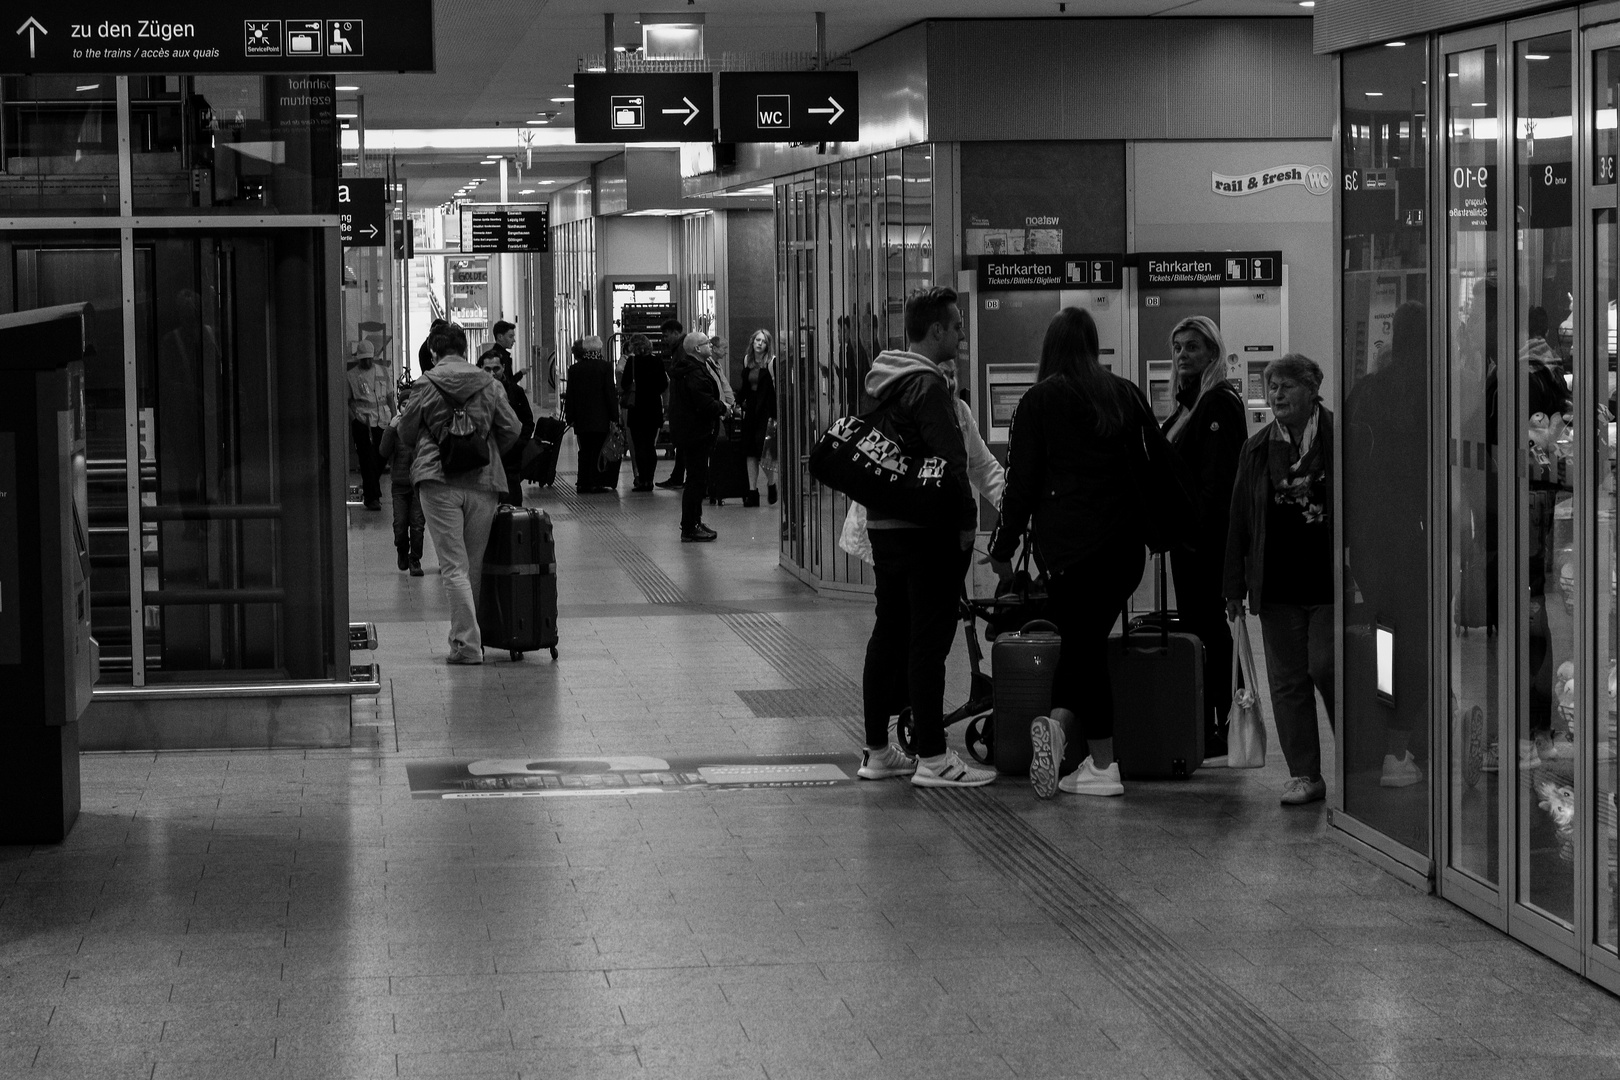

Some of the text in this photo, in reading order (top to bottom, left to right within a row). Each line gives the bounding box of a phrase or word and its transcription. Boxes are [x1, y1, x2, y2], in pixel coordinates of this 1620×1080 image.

[71, 20, 195, 41] zu den Zügen
[73, 48, 83, 58] to
[86, 48, 102, 58] the
[104, 48, 132, 58] trains
[141, 47, 170, 58] accès
[172, 49, 191, 58] aux
[193, 48, 220, 60] quais
[759, 111, 784, 125] WC
[1215, 168, 1330, 192] rail & fresh WC
[341, 223, 352, 232] ße
[987, 263, 1052, 275] Fahrkarten
[1148, 260, 1212, 272] Fahrkarten
